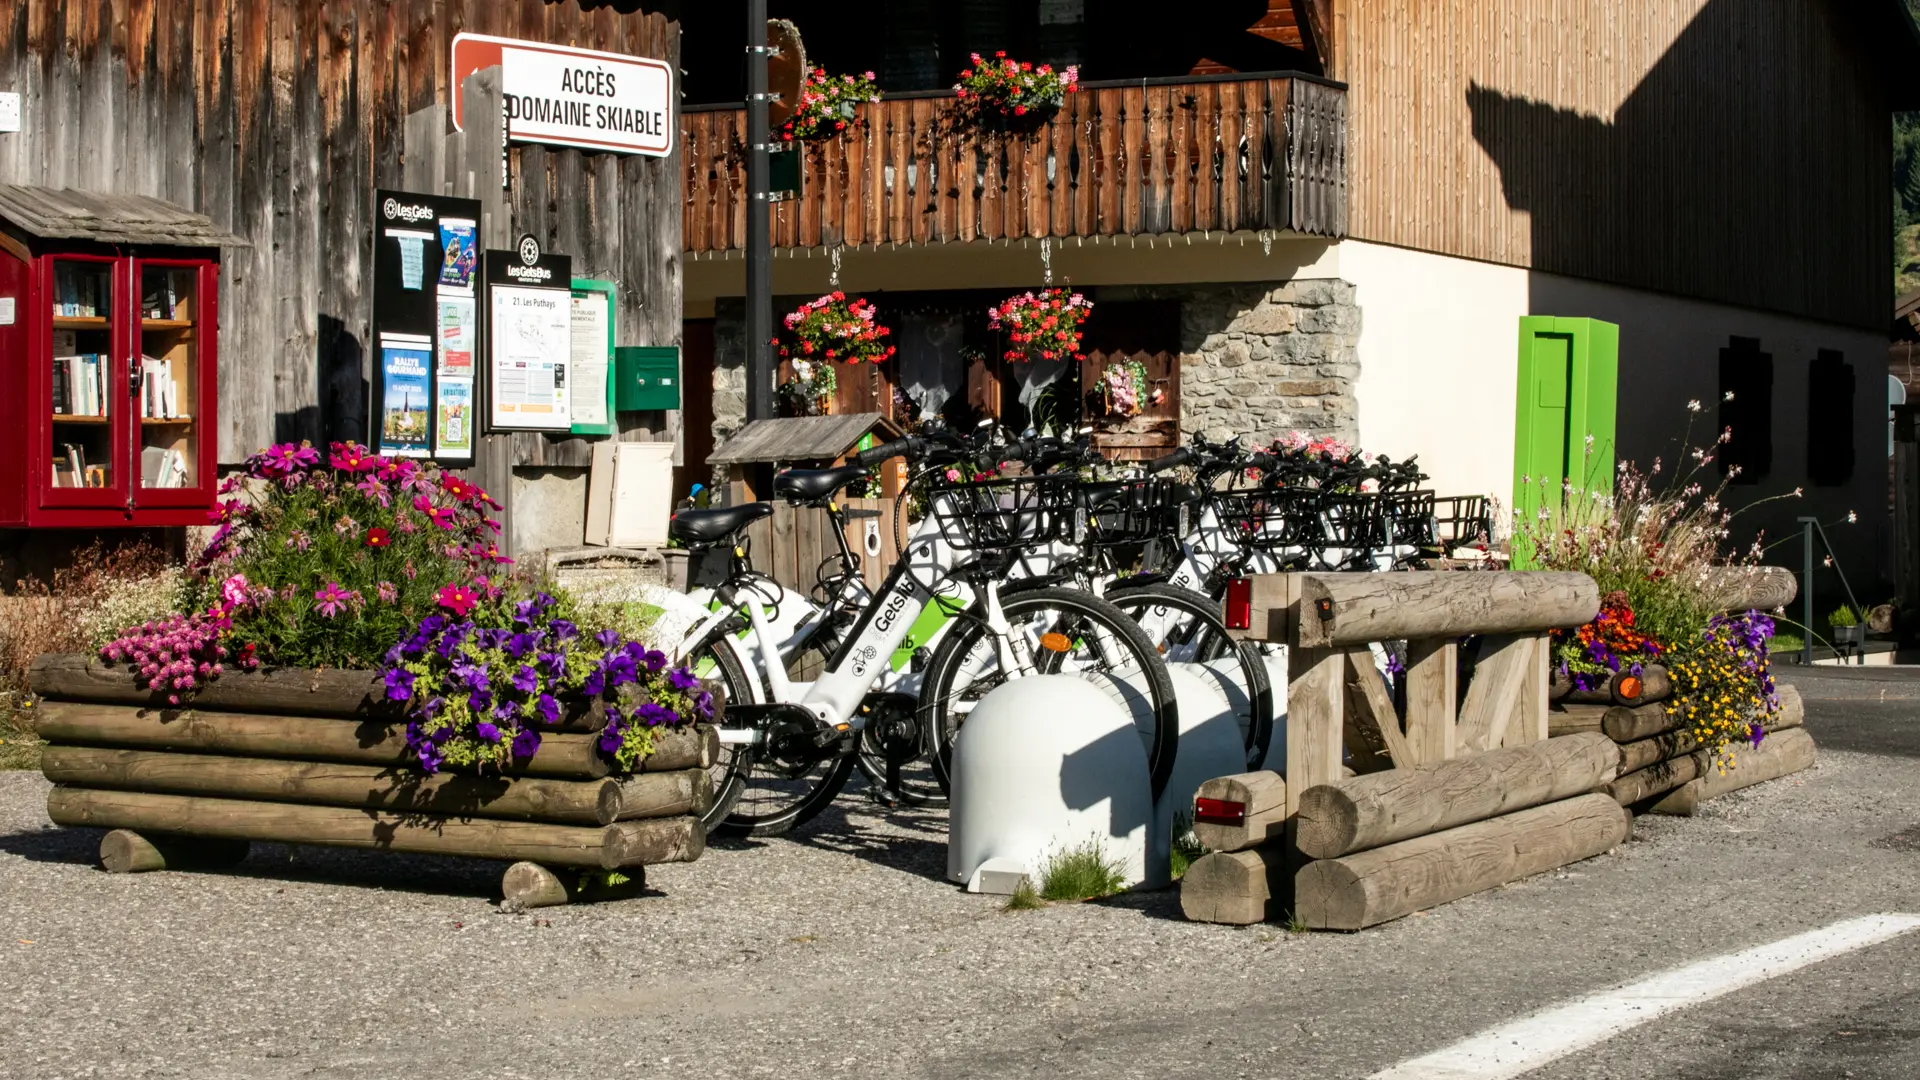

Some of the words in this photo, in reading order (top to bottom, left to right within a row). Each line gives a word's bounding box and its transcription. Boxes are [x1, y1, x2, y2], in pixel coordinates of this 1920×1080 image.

[561, 66, 616, 98] ACCÈS
[510, 95, 591, 128] DOMAINE
[596, 105, 662, 136] SKIABLE
[523, 298, 532, 307] Les
[533, 298, 556, 311] Puthays
